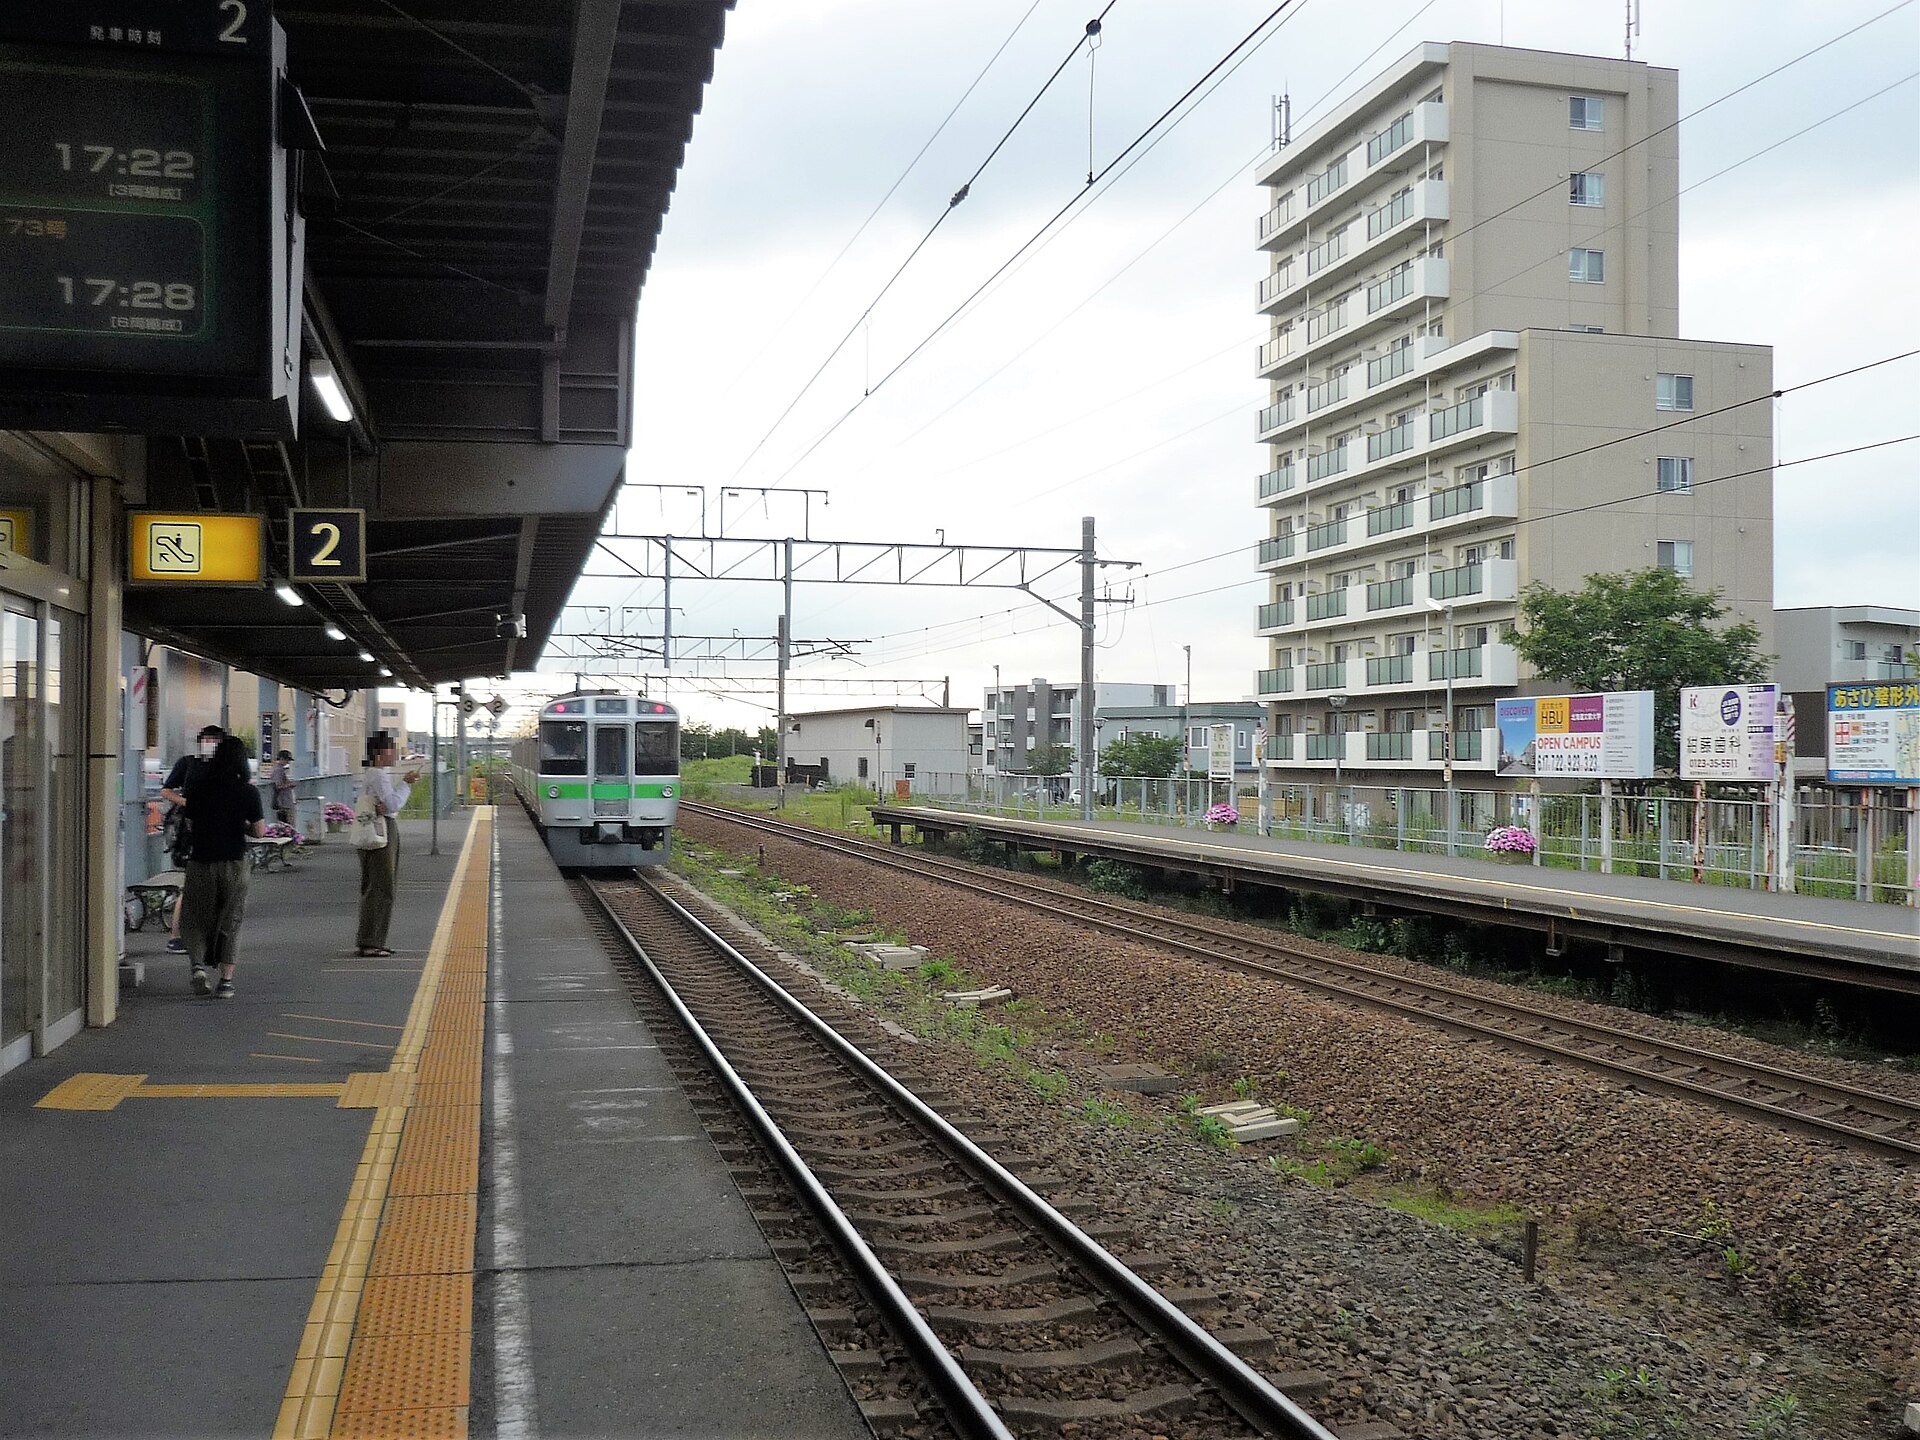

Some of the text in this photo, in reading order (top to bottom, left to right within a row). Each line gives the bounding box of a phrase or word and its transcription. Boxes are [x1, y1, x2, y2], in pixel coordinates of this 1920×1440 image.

[218, 0, 248, 44] 2
[89, 25, 162, 46] 発車時刻
[55, 143, 195, 180] 17:22
[57, 276, 196, 311] 17:28
[310, 522, 342, 566] 2
[463, 700, 474, 713] 3
[492, 701, 503, 713] 2
[1834, 685, 1920, 708] あさひ整形外
[1541, 710, 1564, 725] HBU
[1537, 736, 1601, 750] OPEN CAMPUS
[1689, 758, 1738, 769] 0123-35-5511
